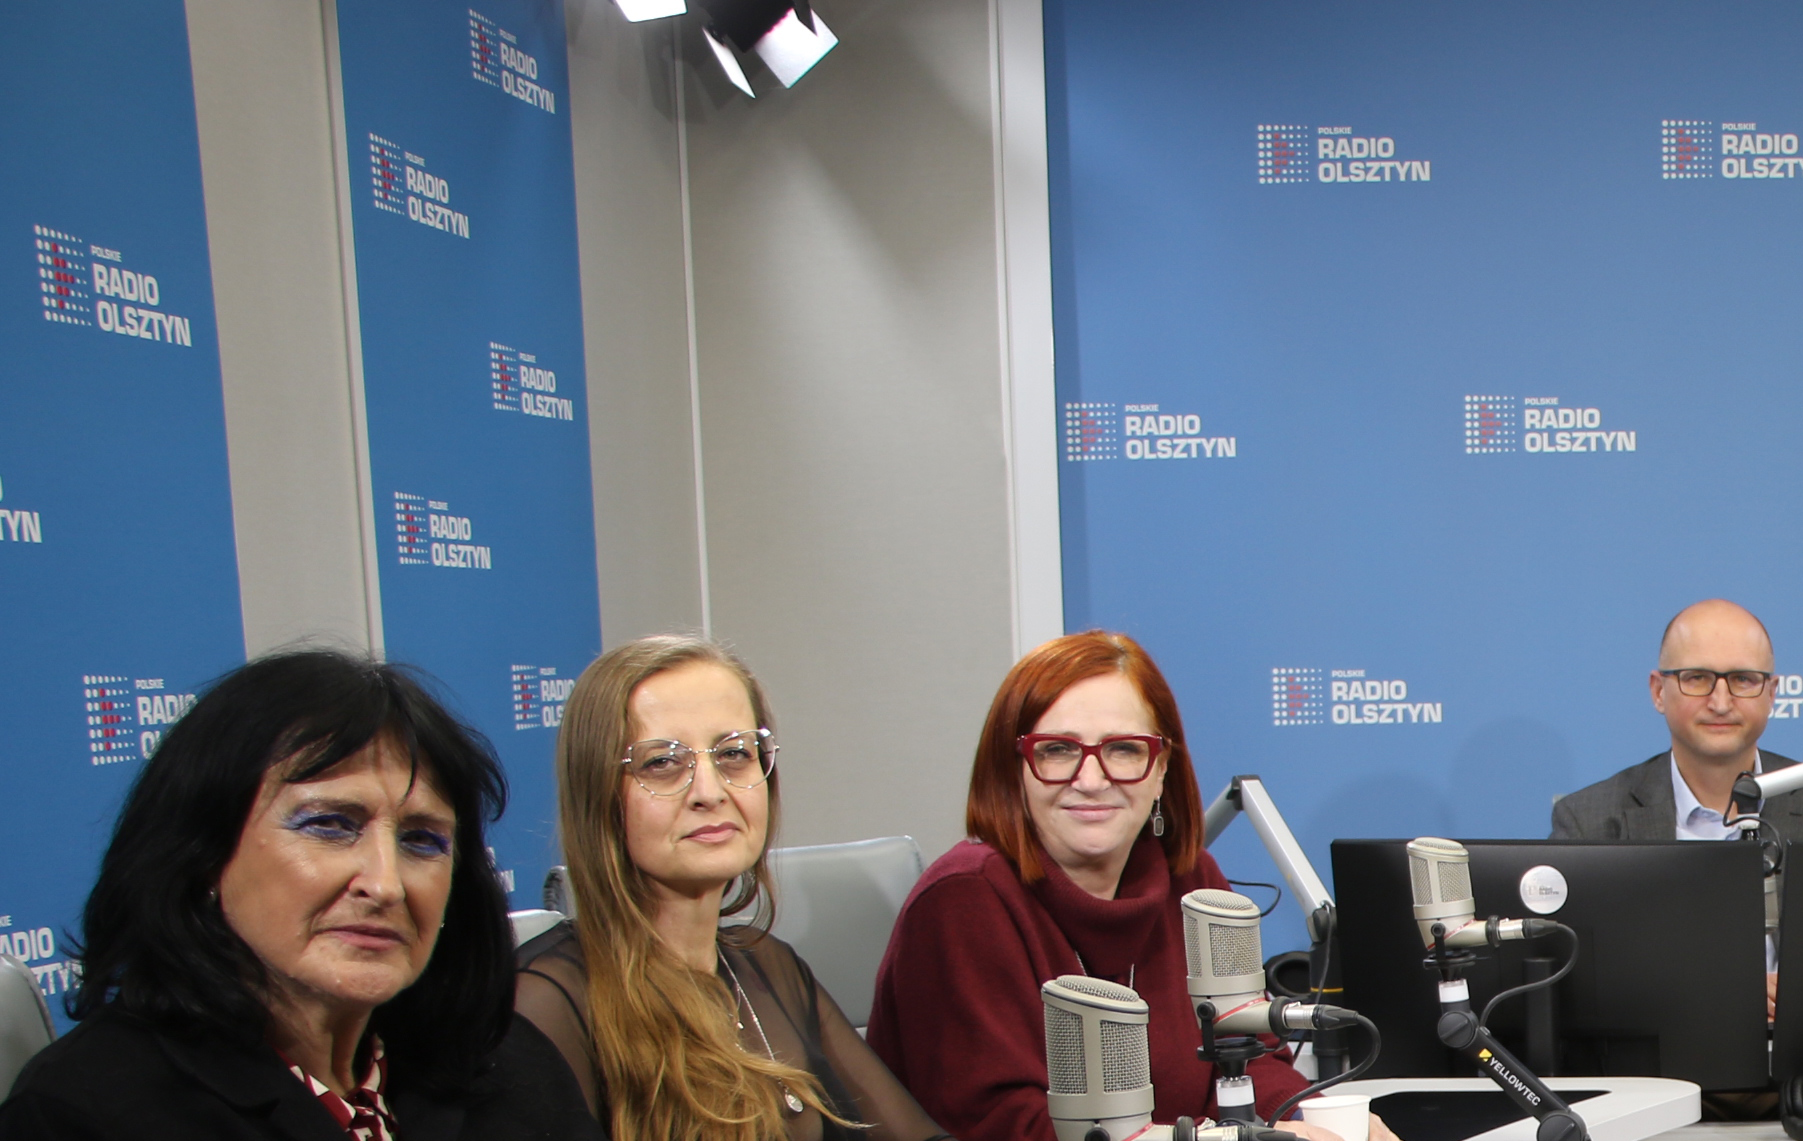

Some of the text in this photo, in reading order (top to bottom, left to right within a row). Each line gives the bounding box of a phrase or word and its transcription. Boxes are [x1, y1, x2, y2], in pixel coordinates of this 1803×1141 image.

[500, 42, 538, 80] RADIO
[502, 70, 555, 114] OLSZTYN
[1318, 137, 1394, 158] RADIO
[1722, 134, 1798, 154] RADIO
[406, 165, 449, 204] RADIO
[1318, 161, 1430, 182] OLSZTYN
[408, 195, 470, 240] OLSZTYN
[92, 263, 160, 306] RADIO
[97, 300, 192, 348] OLSZTYN
[520, 365, 556, 393] RADIO
[522, 391, 573, 421] OLSZTYN
[1525, 408, 1600, 428] RADIO
[1125, 414, 1200, 435] RADIO
[1126, 437, 1235, 459] OLSZTYN
[1525, 431, 1635, 452] OLSZTYN
[430, 514, 471, 541] RADIO
[432, 542, 492, 569] OLSZTYN
[1332, 680, 1406, 700] RADIO
[1332, 703, 1441, 724] OLSZTYN
[0, 927, 55, 963] ADIO
[1489, 1056, 1541, 1106] YELLOWTEC
